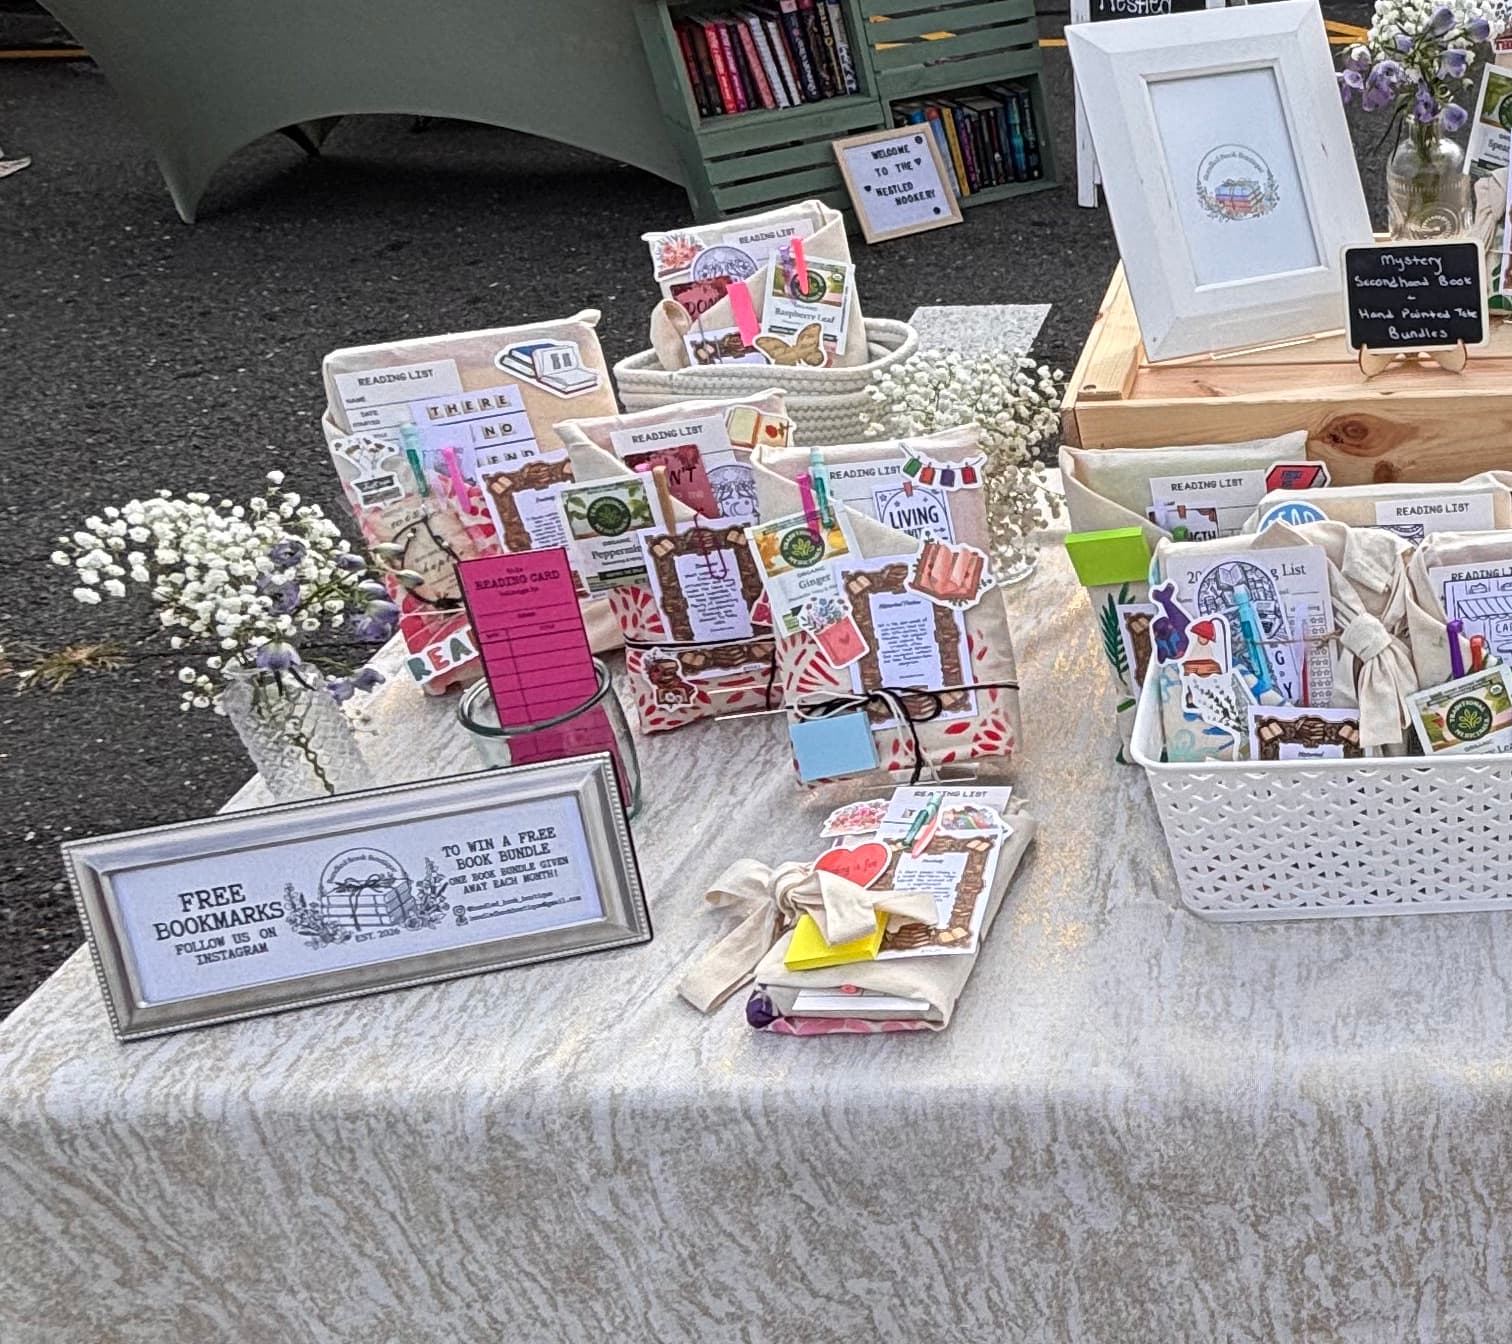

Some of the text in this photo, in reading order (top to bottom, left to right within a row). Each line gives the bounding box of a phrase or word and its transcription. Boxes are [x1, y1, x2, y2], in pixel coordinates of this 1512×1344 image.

[871, 144, 911, 159] WELCOME
[875, 161, 914, 177] TO THE
[875, 181, 914, 197] NESTLED
[895, 189, 936, 206] NOOKERY
[739, 227, 796, 244] READING LIST
[1381, 254, 1443, 275] Mystery
[1354, 275, 1472, 288] Secondhand Book
[775, 307, 835, 324] Raspberry Leaf
[1358, 308, 1394, 319] Hand
[1401, 308, 1451, 319] Painted
[1388, 325, 1448, 340] Bundles
[358, 369, 434, 387] READING LIST
[428, 394, 510, 419] THERE
[485, 422, 514, 438] NO
[632, 424, 704, 444] READING LIST
[829, 466, 876, 481] READING
[1171, 478, 1243, 492] READING LIST
[889, 505, 940, 530] LIVING
[1396, 502, 1470, 517] READING LIST
[1281, 563, 1307, 578] List
[1451, 569, 1498, 582] READING
[475, 570, 561, 591] READING CARD
[799, 573, 832, 590] Ginger
[407, 630, 477, 683] REA
[962, 790, 988, 798] LIST
[442, 826, 557, 858] TO WIN A FREE
[455, 842, 551, 871] BOOK BUNDLE
[448, 855, 569, 887] ONE BOOK BUNDLE GIVEN
[463, 869, 559, 895] AWAY EACH MONTH!
[178, 883, 246, 913] FREE
[153, 901, 285, 941] BOOKMARKS
[175, 926, 278, 956] FOLLOW US ON
[196, 942, 270, 966] INSTAGRAM
